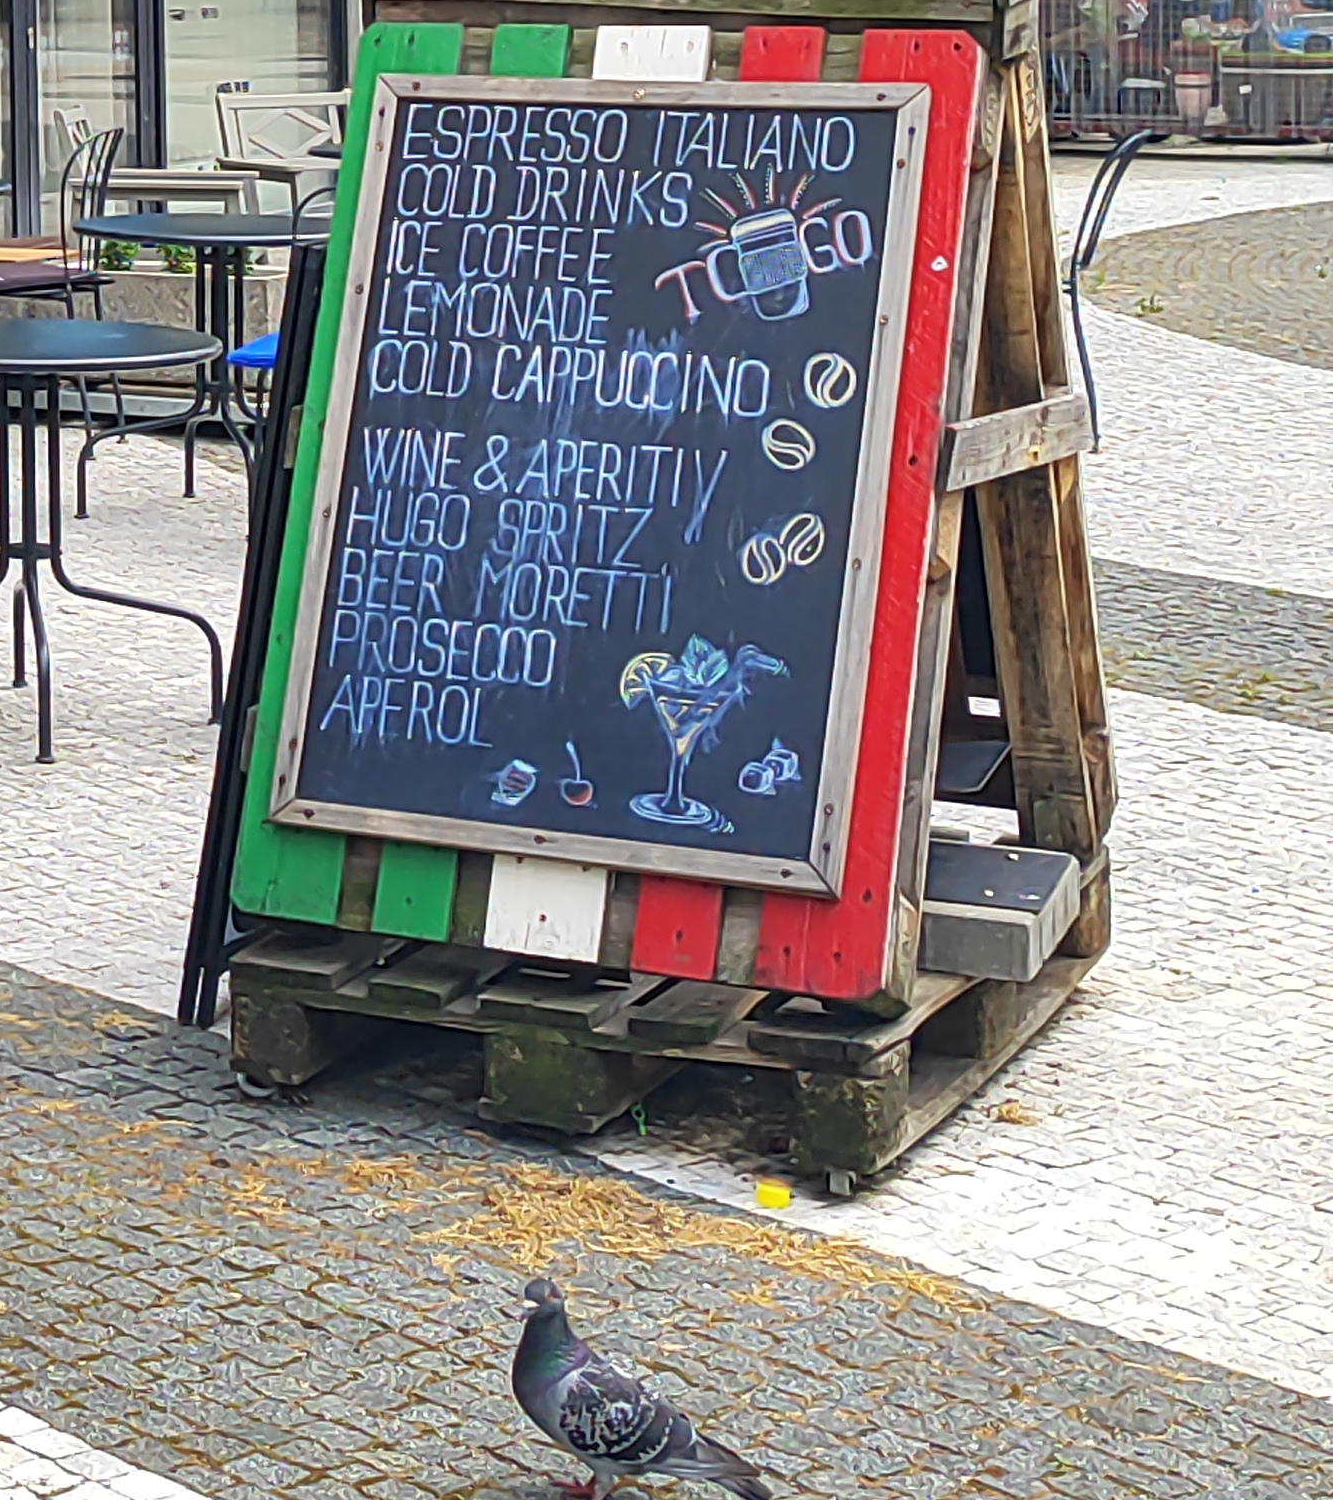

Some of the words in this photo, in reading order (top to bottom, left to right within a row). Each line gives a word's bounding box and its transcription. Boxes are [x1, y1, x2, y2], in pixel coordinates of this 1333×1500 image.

[402, 103, 629, 164] ESPRESSO
[653, 110, 856, 172] ITALIANO
[397, 162, 498, 219] COLD
[507, 165, 694, 228] DRINKS
[386, 217, 444, 277] ICE
[459, 222, 616, 285] COFFEE
[654, 244, 751, 326] TO
[799, 209, 874, 275] GO
[377, 277, 613, 346] LEMONADE
[370, 339, 473, 399] COLD
[491, 343, 771, 418] CAPPUCCINO
[363, 426, 467, 491] WINE
[473, 434, 509, 494] &
[345, 485, 471, 552] HUGO
[492, 497, 654, 569] SPRITZ
[336, 548, 446, 614] BEER
[474, 557, 673, 635] MORETTI
[328, 609, 557, 688] PROSECCO
